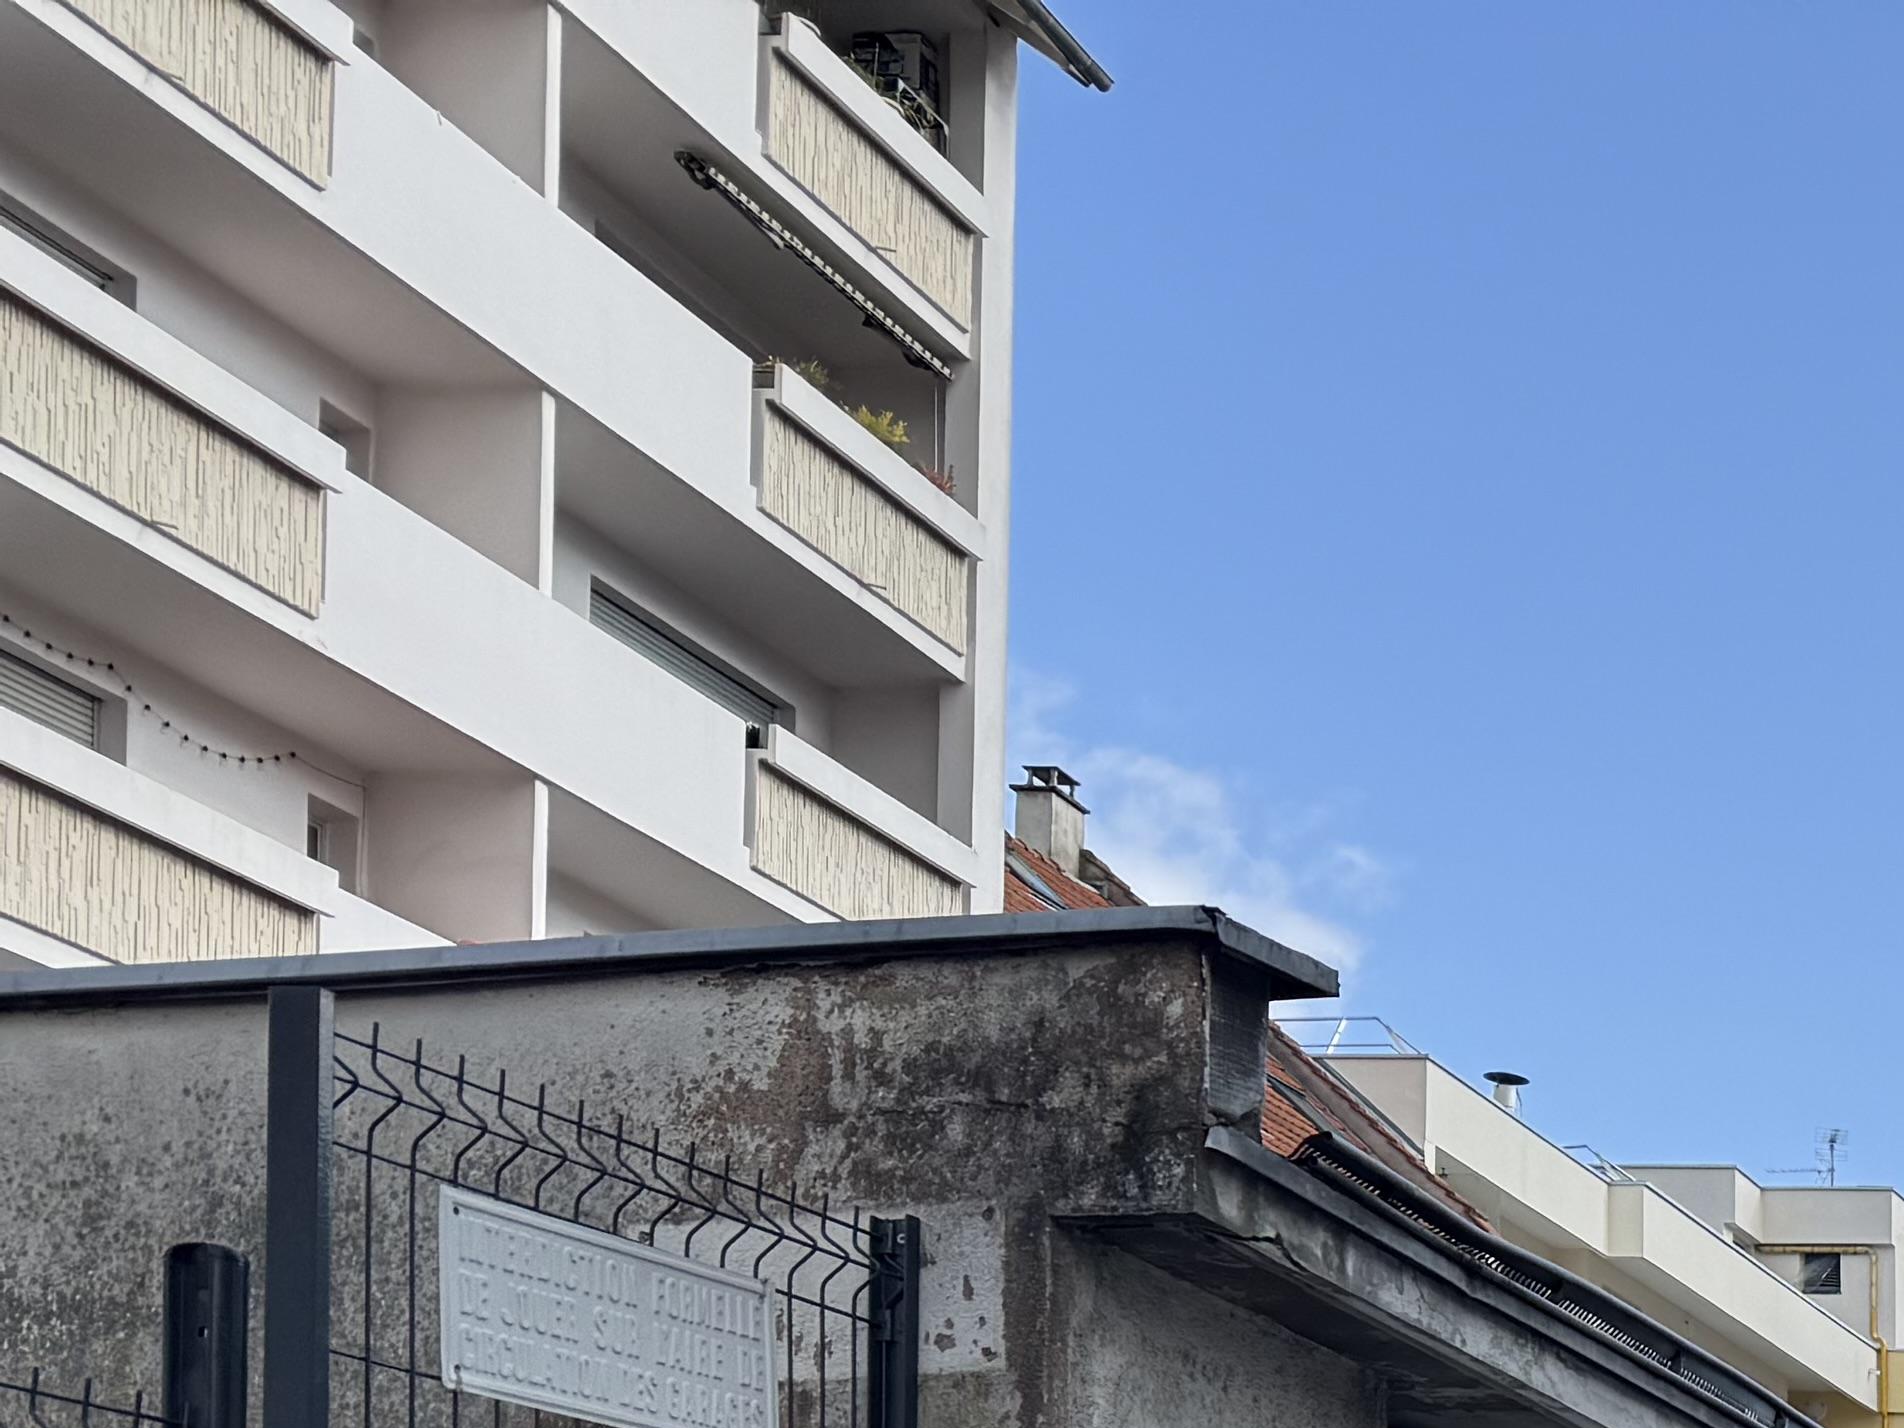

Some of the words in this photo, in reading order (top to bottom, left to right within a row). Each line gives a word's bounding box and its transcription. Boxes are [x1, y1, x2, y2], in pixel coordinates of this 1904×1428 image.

[457, 1214, 638, 1309] INTERDICTION
[652, 1271, 761, 1343] FORMELLE
[458, 1267, 489, 1323] DE
[500, 1279, 579, 1346] JOUER
[593, 1304, 639, 1361] SUR
[653, 1320, 723, 1383] L'AIRE
[738, 1343, 763, 1393] DE
[459, 1321, 609, 1404] CIRCULATION
[617, 1362, 657, 1416] DES
